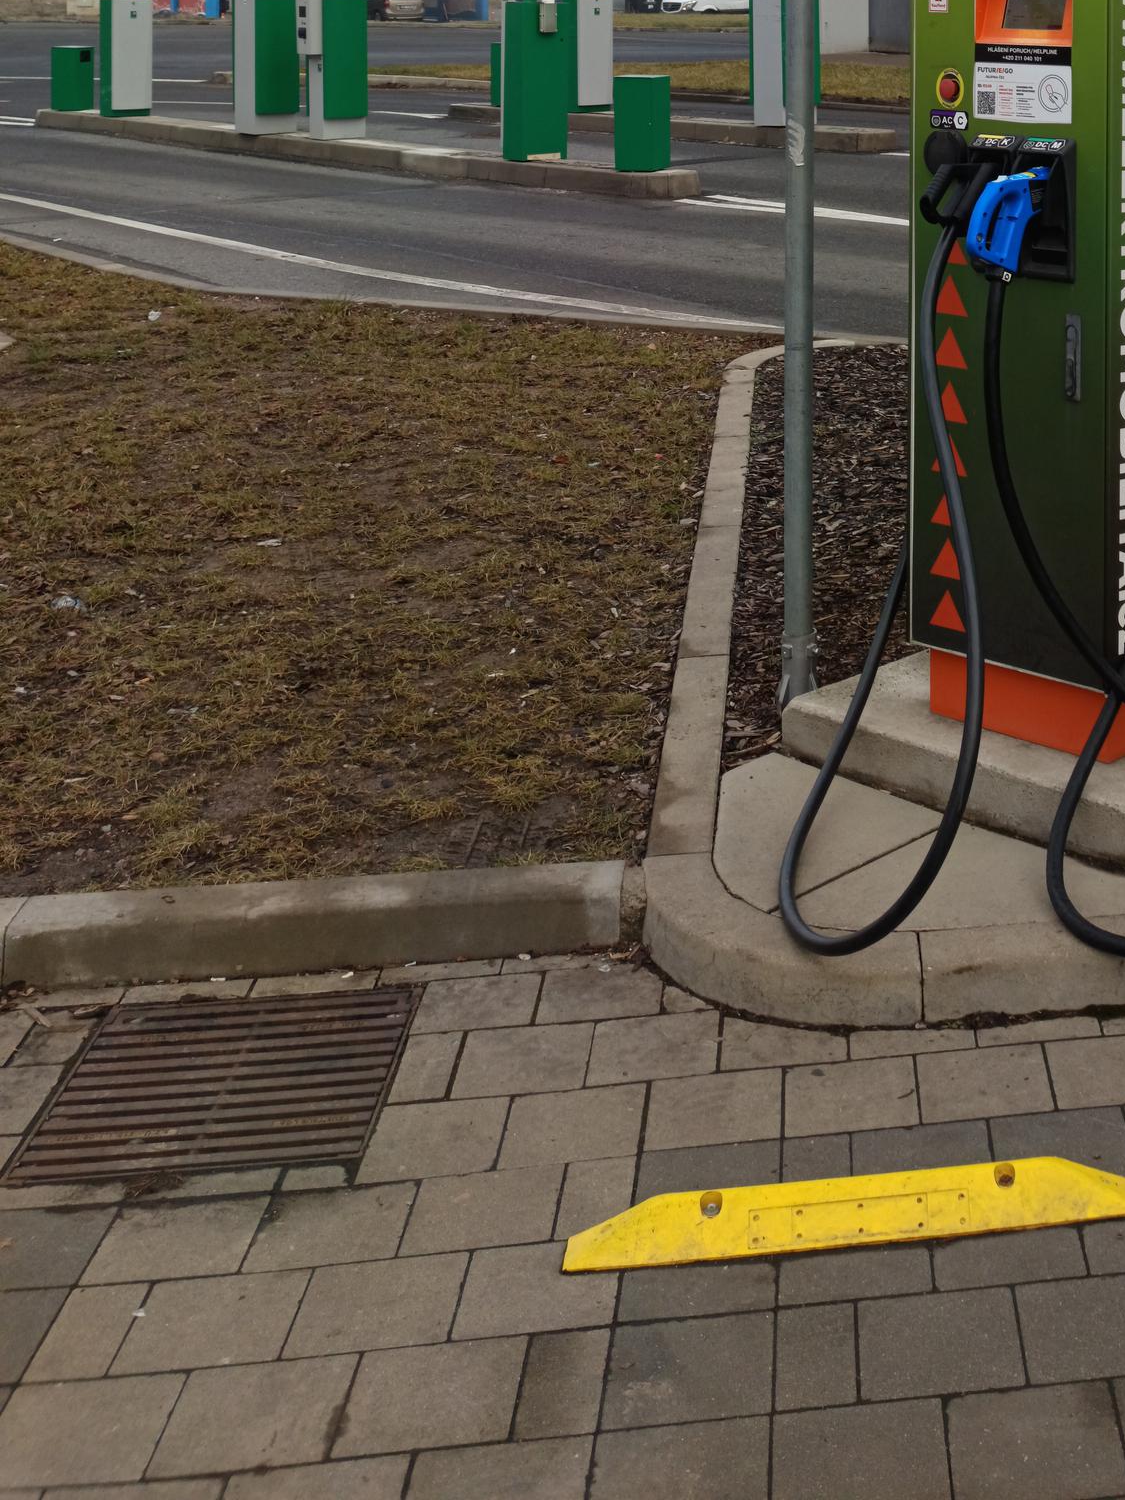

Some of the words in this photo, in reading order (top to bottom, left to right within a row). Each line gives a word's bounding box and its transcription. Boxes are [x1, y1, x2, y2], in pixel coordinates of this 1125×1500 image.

[942, 116, 953, 124] AC
[957, 116, 964, 124] C
[1001, 138, 1011, 146] K
[1050, 141, 1061, 149] M
